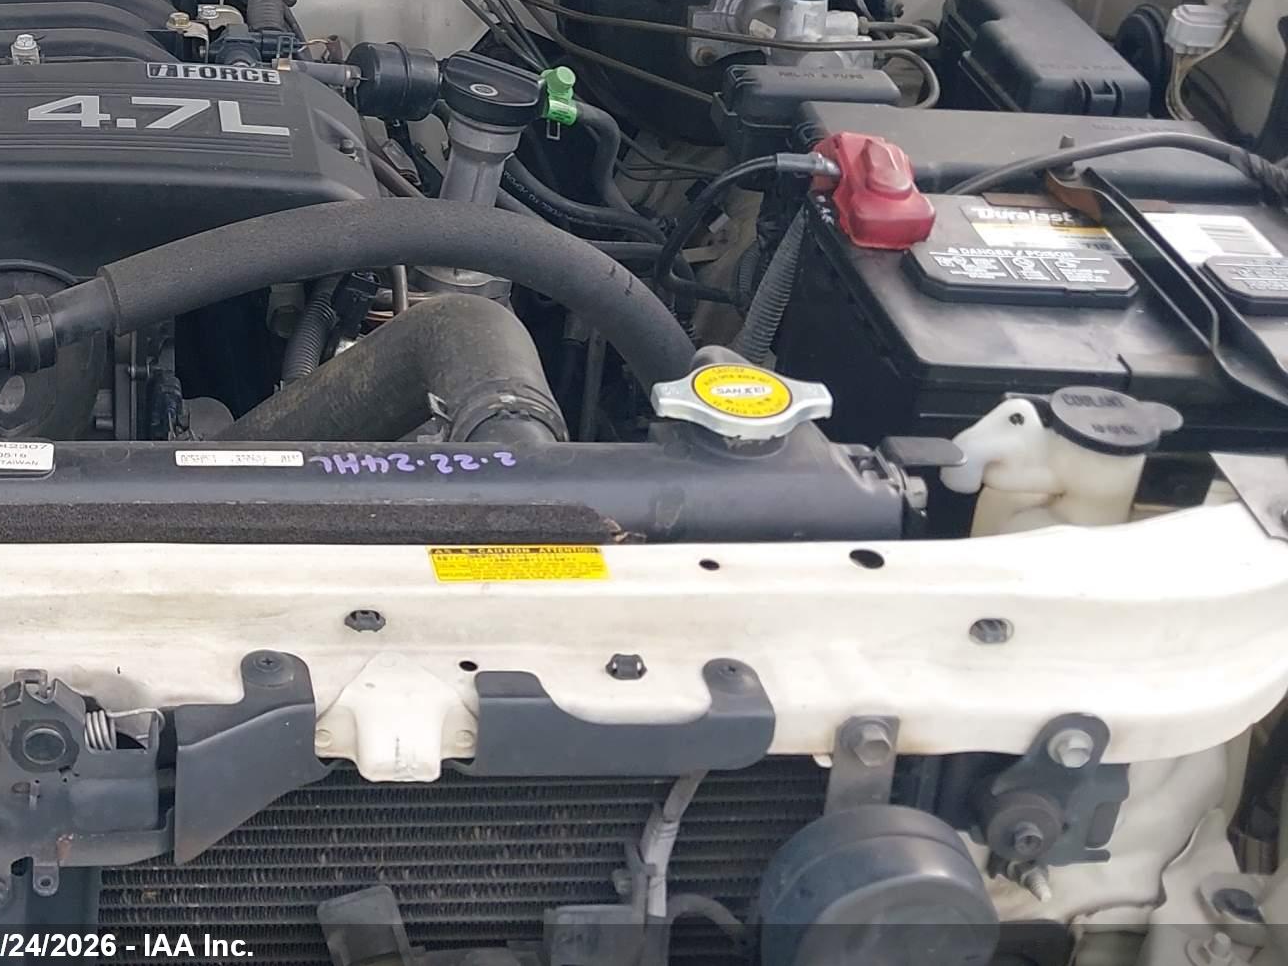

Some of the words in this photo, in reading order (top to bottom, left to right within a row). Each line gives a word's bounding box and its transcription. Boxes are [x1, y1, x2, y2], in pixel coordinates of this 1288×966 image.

[27, 95, 290, 135] 4.7L
[972, 206, 1076, 224] Duralast
[962, 247, 1013, 256] DANGER
